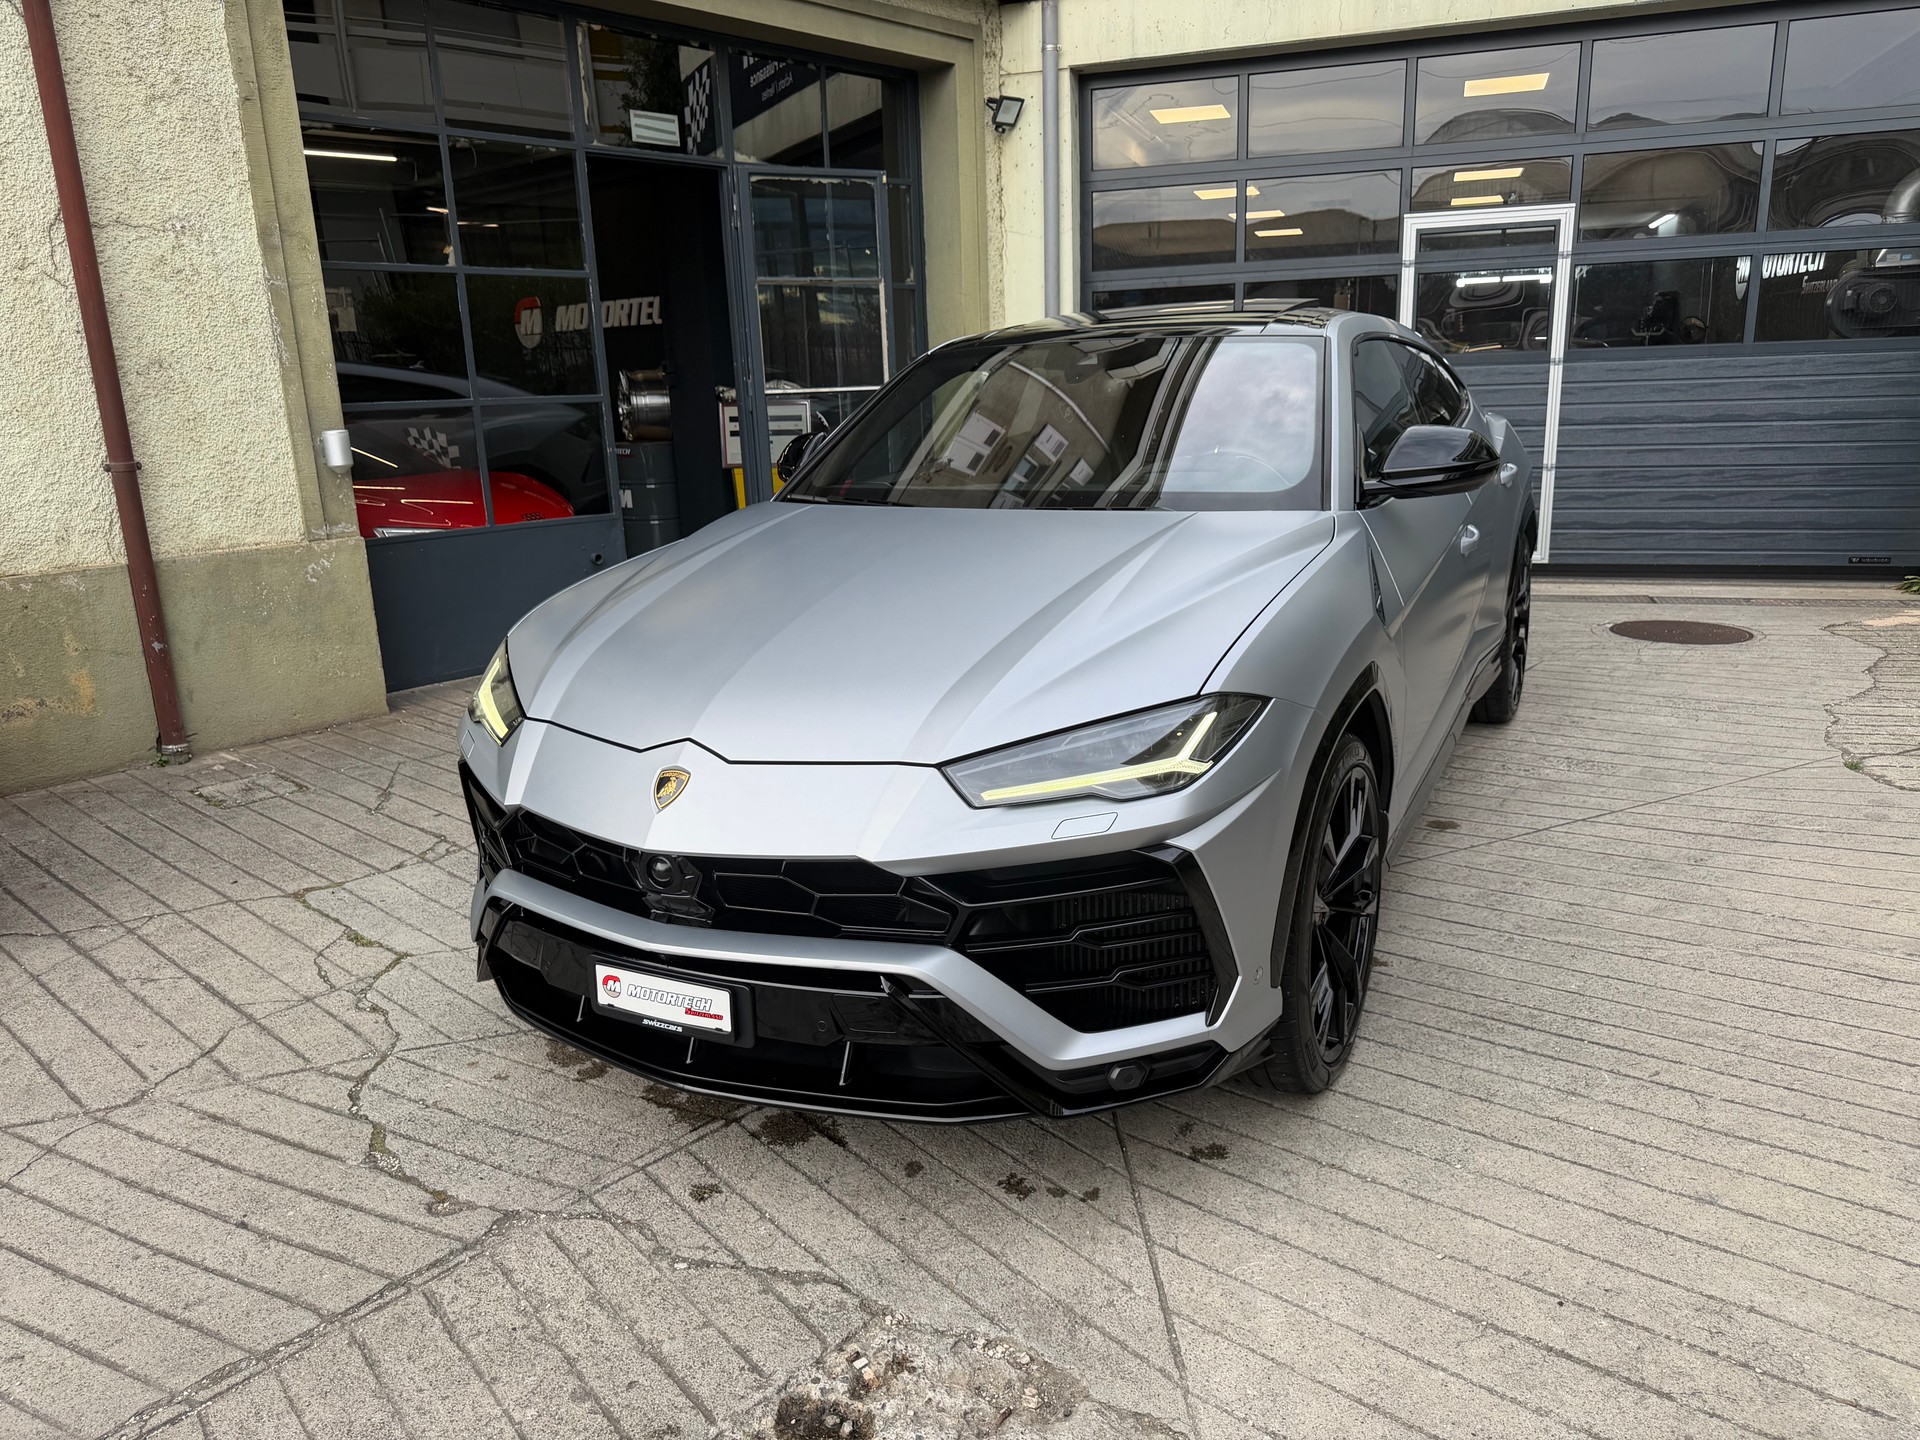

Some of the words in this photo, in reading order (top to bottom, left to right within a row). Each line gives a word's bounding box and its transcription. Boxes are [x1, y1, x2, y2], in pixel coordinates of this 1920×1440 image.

[1762, 252, 1826, 280] OTORTECH
[627, 984, 713, 1012] MOTORTECH
[642, 1018, 683, 1033] swizzcars
